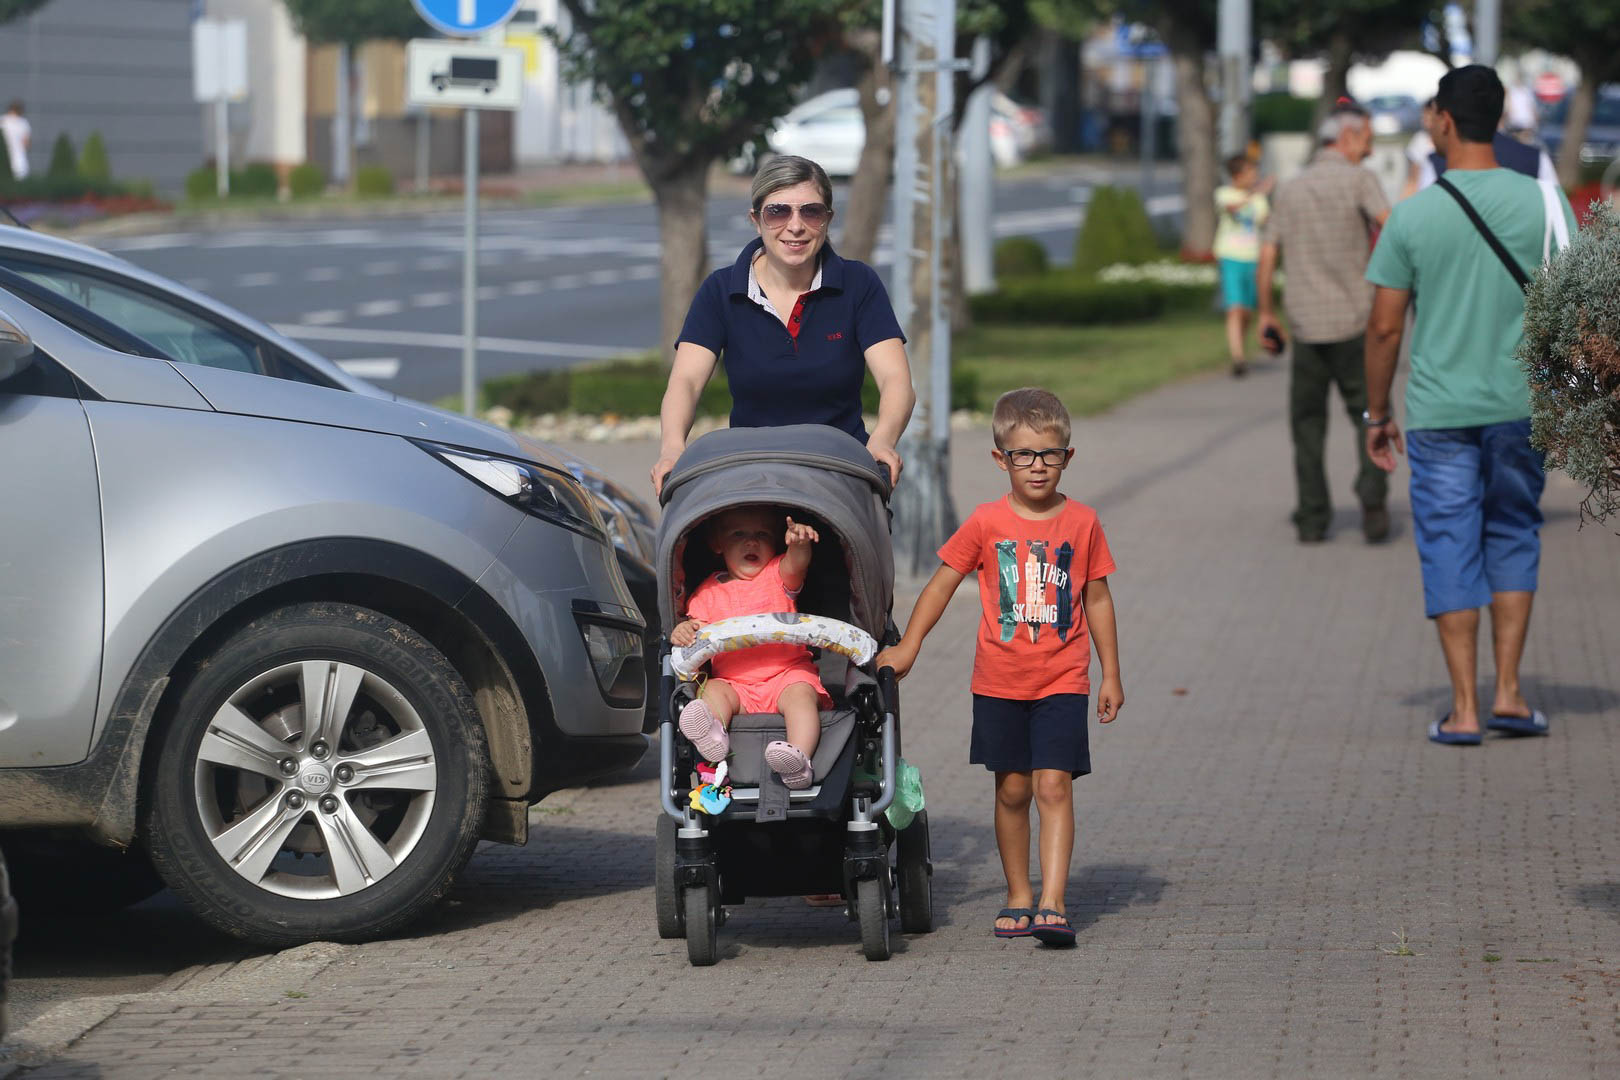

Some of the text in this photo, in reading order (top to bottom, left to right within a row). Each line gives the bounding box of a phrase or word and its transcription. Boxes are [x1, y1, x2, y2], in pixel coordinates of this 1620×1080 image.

[1002, 562, 1068, 590] I'D RATHER
[1028, 582, 1045, 601] BE
[1012, 603, 1058, 623] SKATING
[306, 774, 326, 784] KIA
